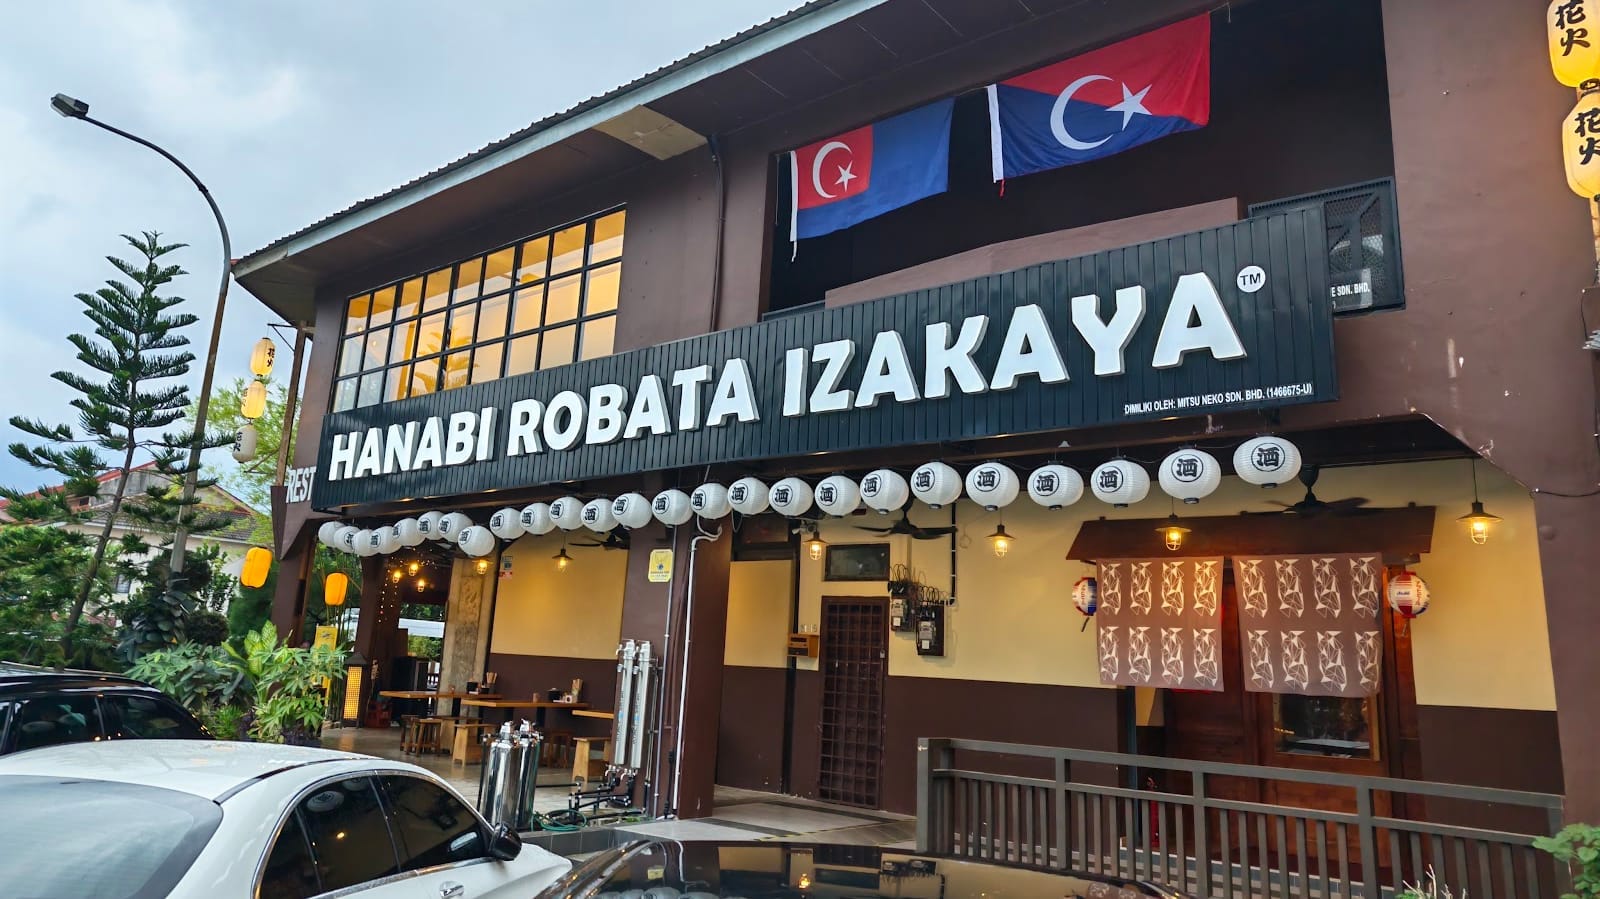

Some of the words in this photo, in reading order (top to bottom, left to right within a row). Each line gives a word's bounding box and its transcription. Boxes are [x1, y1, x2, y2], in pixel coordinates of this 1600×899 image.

[1337, 284, 1353, 297] SDN.
[1354, 281, 1370, 294] BHD.
[328, 406, 497, 481] HANABI
[507, 358, 759, 456] ROBATA
[782, 271, 1247, 417] IZAKAYA
[1240, 271, 1262, 287] TM
[1124, 400, 1152, 415] DIMILIKI
[1154, 397, 1176, 411] OLEH:
[1178, 395, 1200, 409] MITSU
[1202, 392, 1224, 406] NEKO
[1225, 390, 1244, 403] SDN.
[1246, 387, 1265, 400] BHD.
[1257, 447, 1280, 467] 酒
[1177, 457, 1199, 477] 酒
[864, 477, 877, 493] 酒
[916, 472, 931, 488] 酒
[977, 471, 995, 488] 酒
[1036, 475, 1054, 492] 酒
[1099, 471, 1118, 488] 酒
[731, 487, 745, 501] 酒
[775, 488, 790, 502] 酒
[820, 487, 835, 502] 酒
